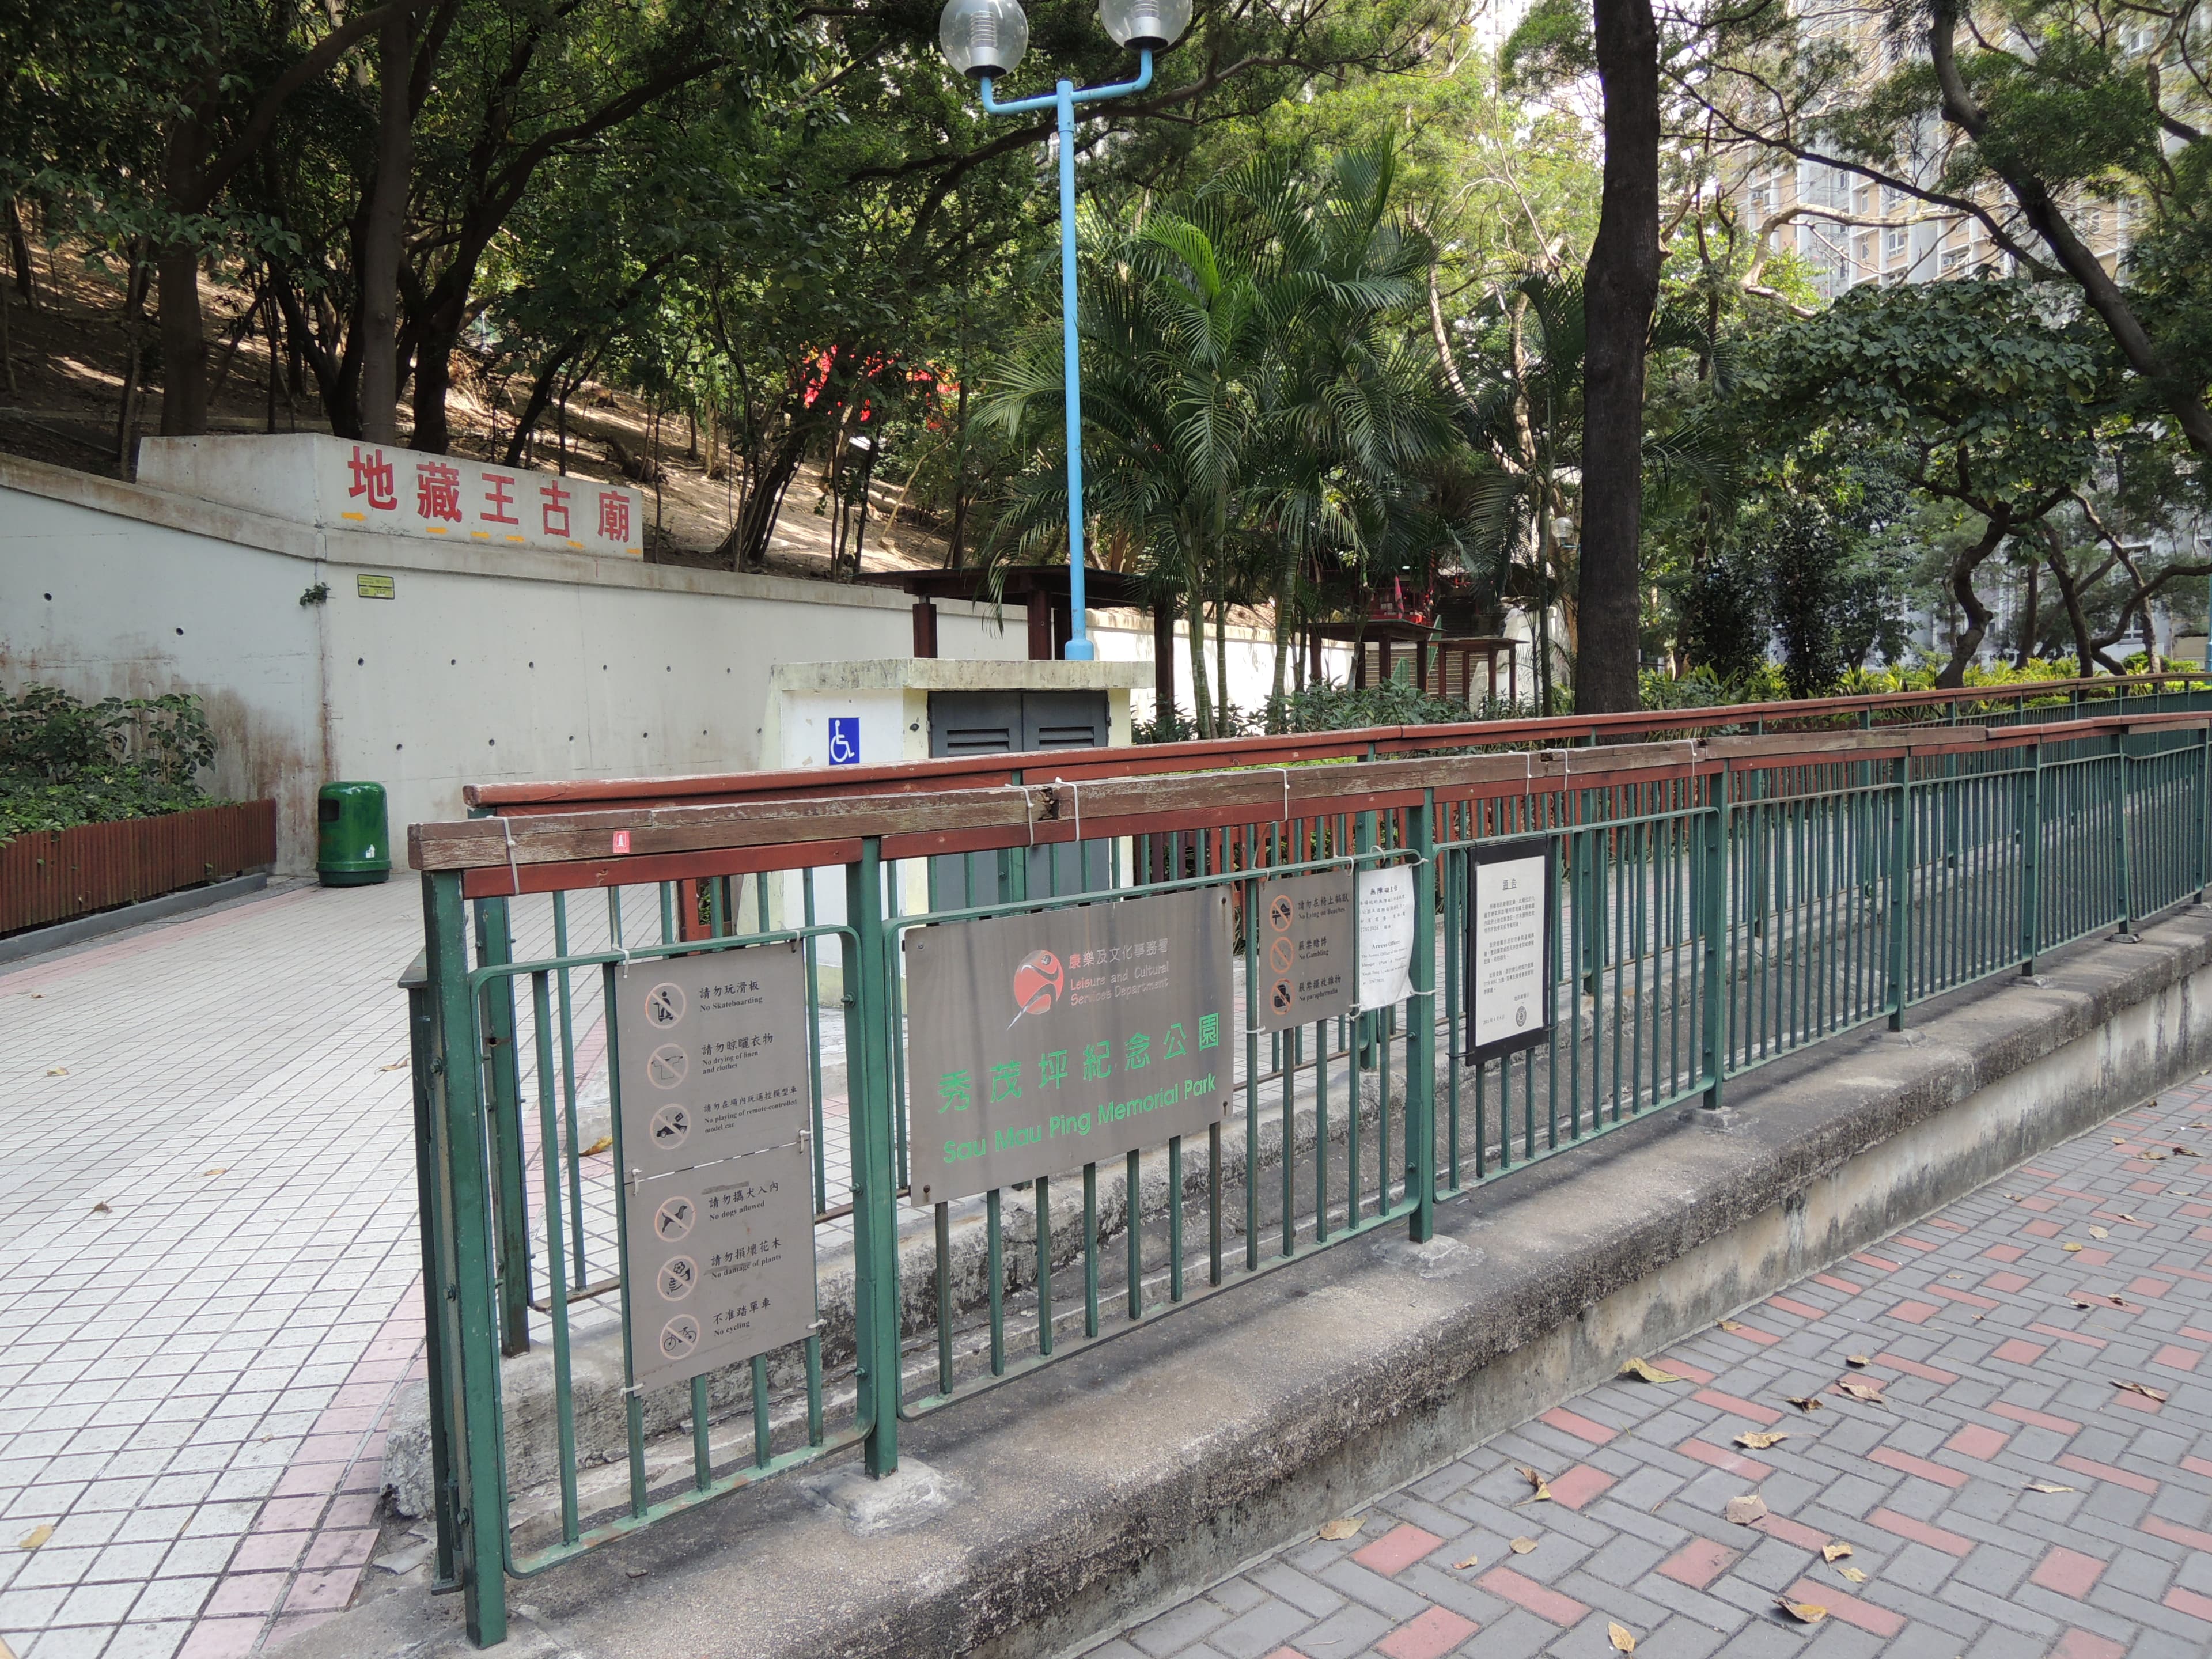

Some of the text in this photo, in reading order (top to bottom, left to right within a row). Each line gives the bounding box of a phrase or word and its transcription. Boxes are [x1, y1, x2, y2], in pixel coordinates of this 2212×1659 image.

[347, 445, 630, 543] 地藏王古廟
[1069, 938, 1168, 969] 康樂及文化事務署
[1306, 949, 1329, 959] Gambling
[1070, 960, 1169, 991] Leisure and Cultural
[699, 980, 760, 999] 請勿玩滑板
[1115, 978, 1169, 1000] Department
[712, 997, 763, 1009] Skateboarding
[702, 1033, 774, 1055] 請勿晾曬衣物
[713, 1055, 734, 1064] drying
[717, 1063, 737, 1072] clothes
[938, 1013, 1219, 1115] 秀茂坪紀念公園
[715, 1113, 737, 1123] playing
[747, 1099, 797, 1115] remote-controlled
[942, 1073, 1217, 1164] Sau Mau Ping Memorial Park
[705, 1124, 723, 1134] model
[709, 1181, 778, 1209] 請勿攜犬入內
[709, 1200, 765, 1221] No dogs allowed
[711, 1237, 781, 1266] 請勿損壞花木
[724, 1264, 750, 1276] damage
[752, 1259, 759, 1267] of
[761, 1254, 781, 1266] plants
[713, 1297, 771, 1325] 不准踏單車
[726, 1321, 750, 1334] cycling
